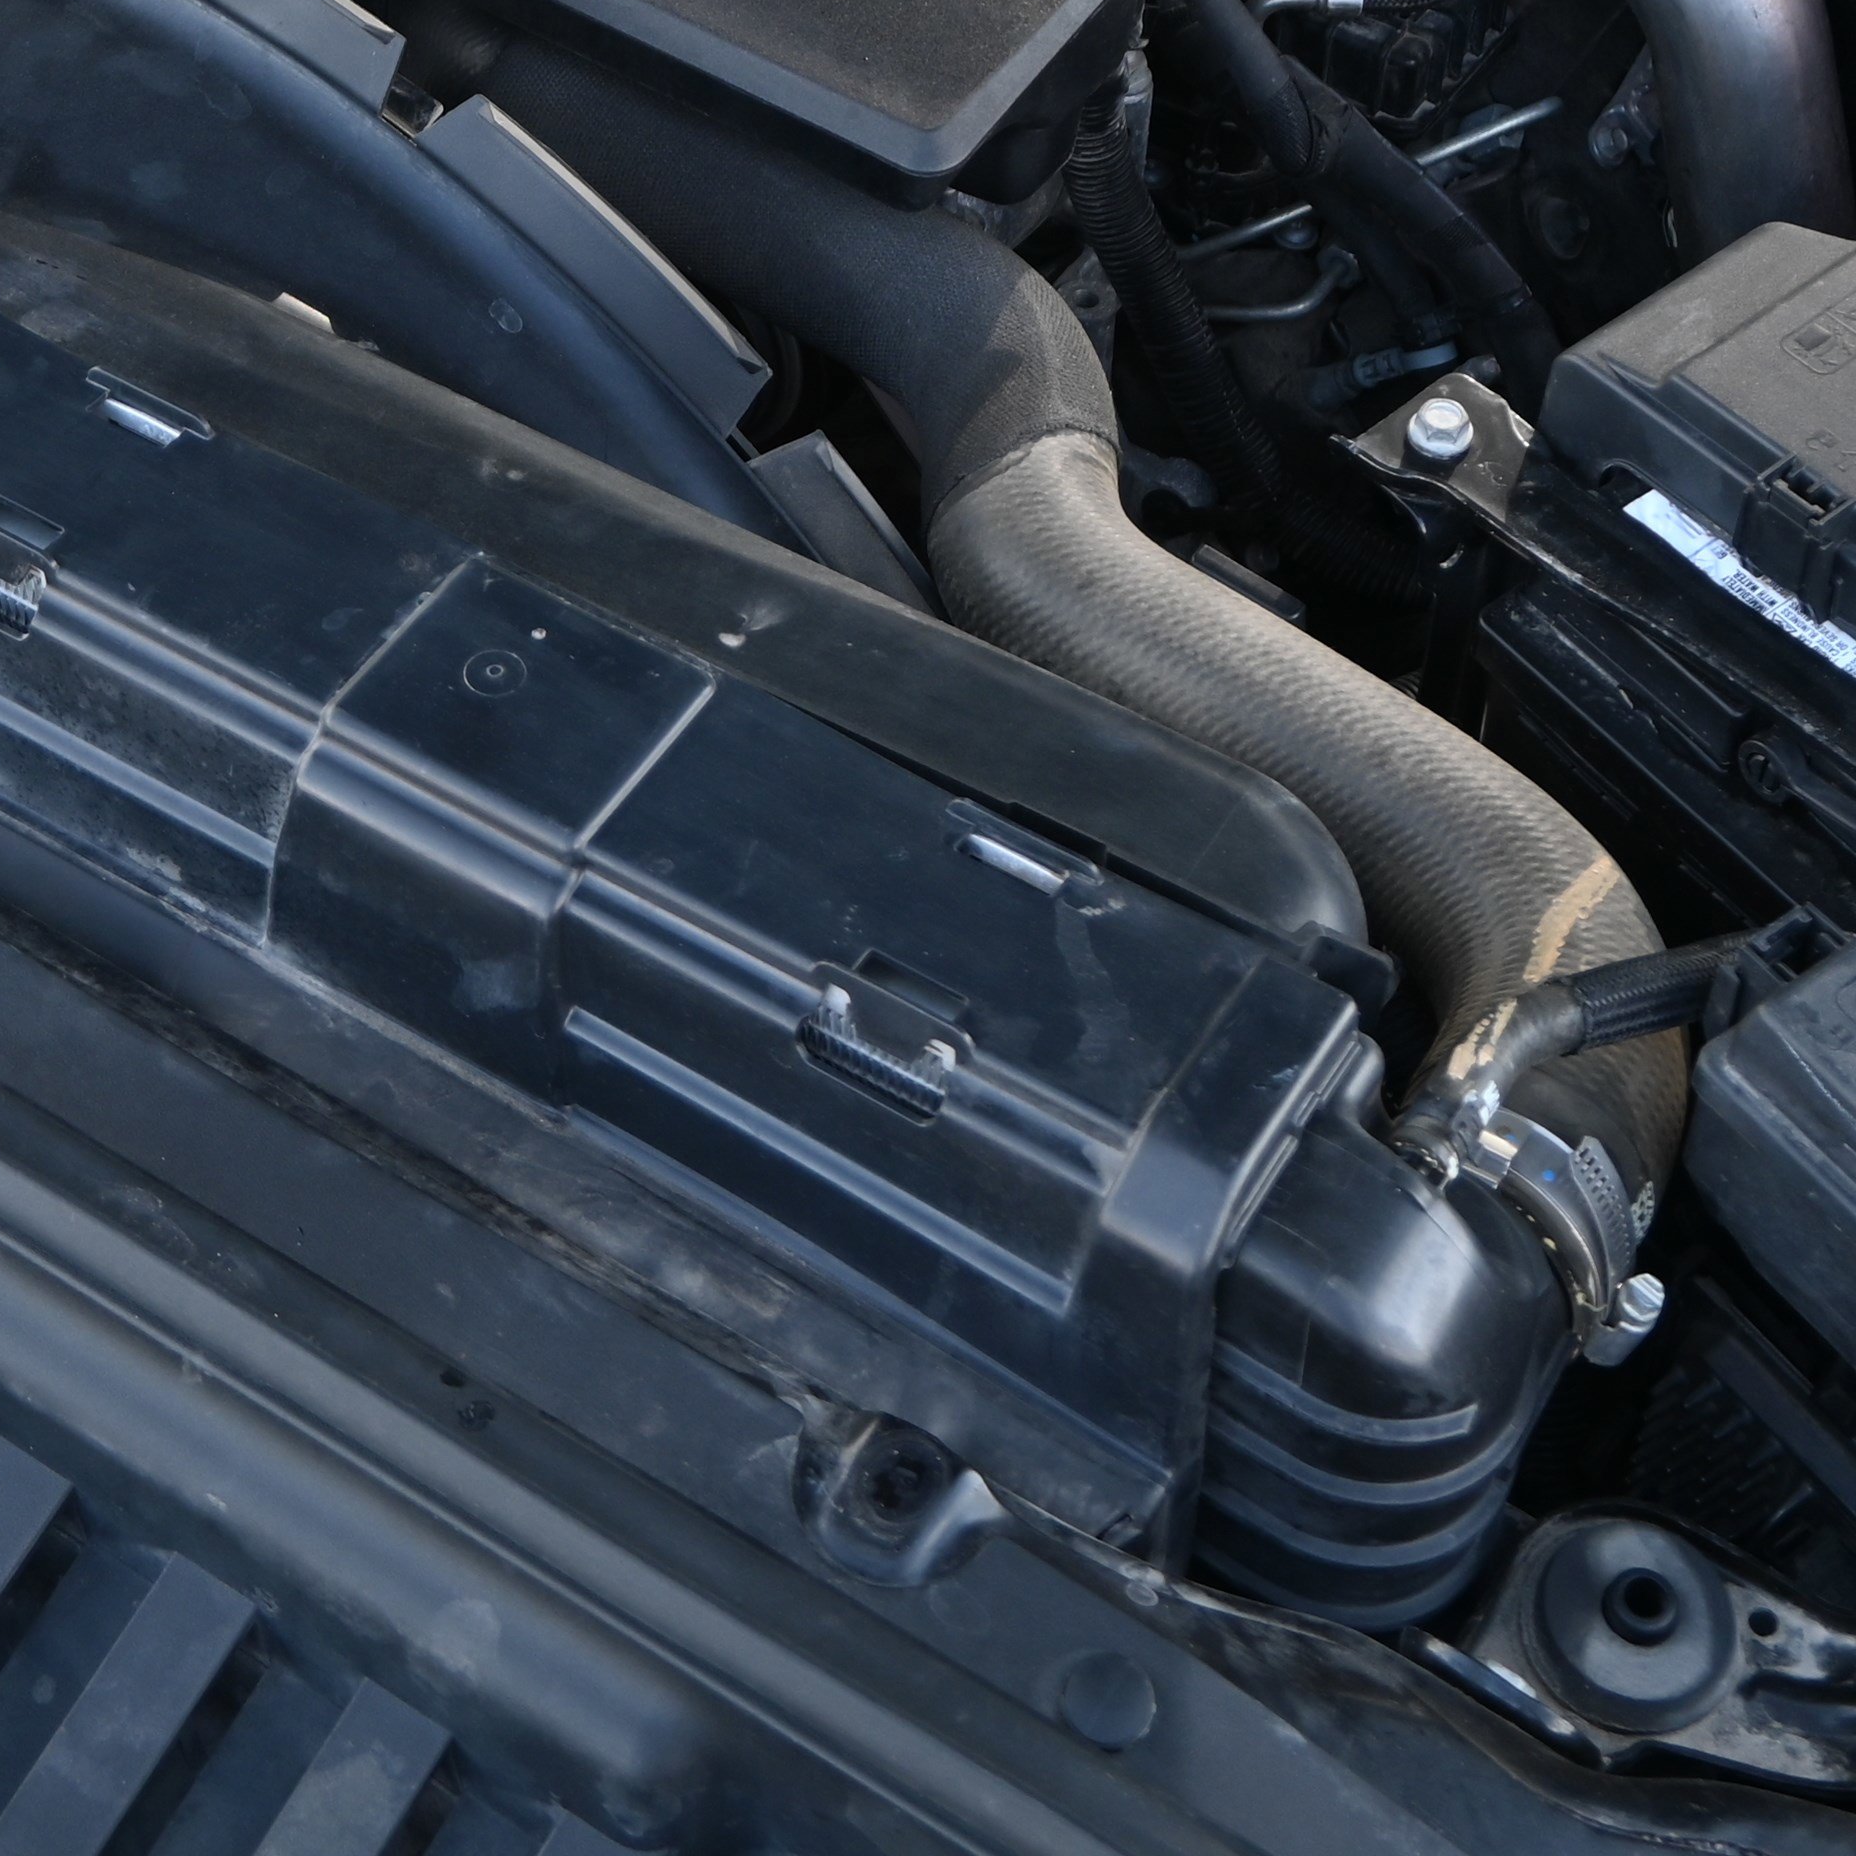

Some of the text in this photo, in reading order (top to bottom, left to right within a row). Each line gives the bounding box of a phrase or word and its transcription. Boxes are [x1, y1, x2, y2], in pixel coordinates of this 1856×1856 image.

[1755, 588, 1778, 608] WITH
[1781, 608, 1840, 657] CAUSE BLINDNESS
